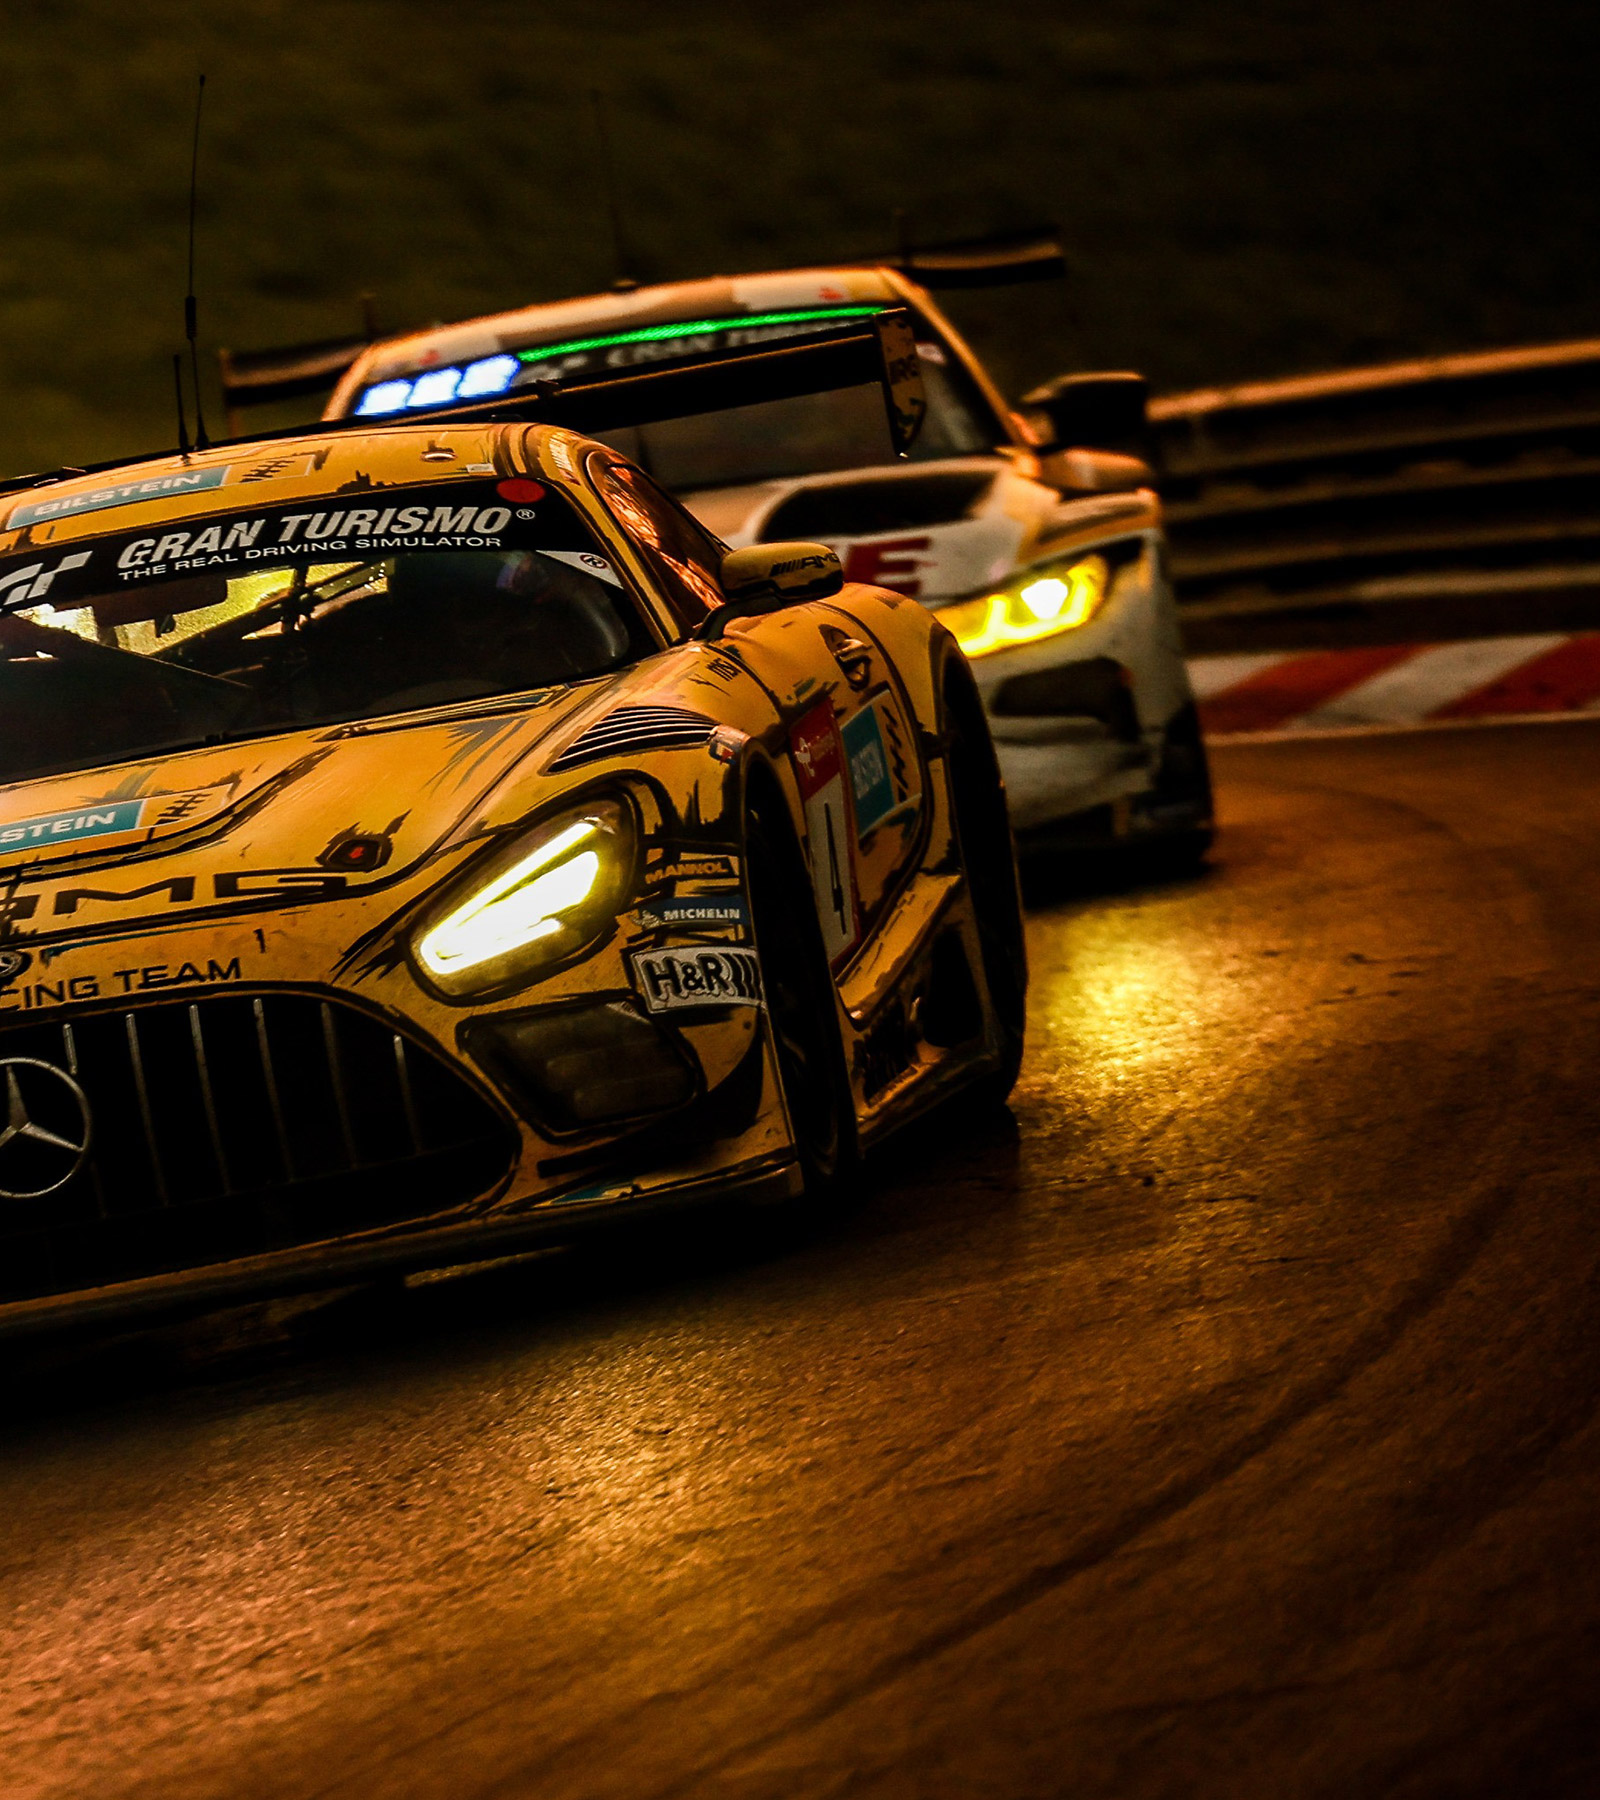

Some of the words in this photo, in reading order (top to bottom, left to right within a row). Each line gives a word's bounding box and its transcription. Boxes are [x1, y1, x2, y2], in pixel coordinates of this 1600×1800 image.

[33, 474, 202, 517] BILSTEIN
[117, 519, 266, 569] GRAN
[118, 567, 153, 582] THE
[174, 556, 216, 571] REAL
[245, 539, 347, 560] DRIVING
[355, 536, 502, 550] SIMULATOR
[664, 907, 741, 921] MICHELIN
[114, 957, 241, 992] TEAM
